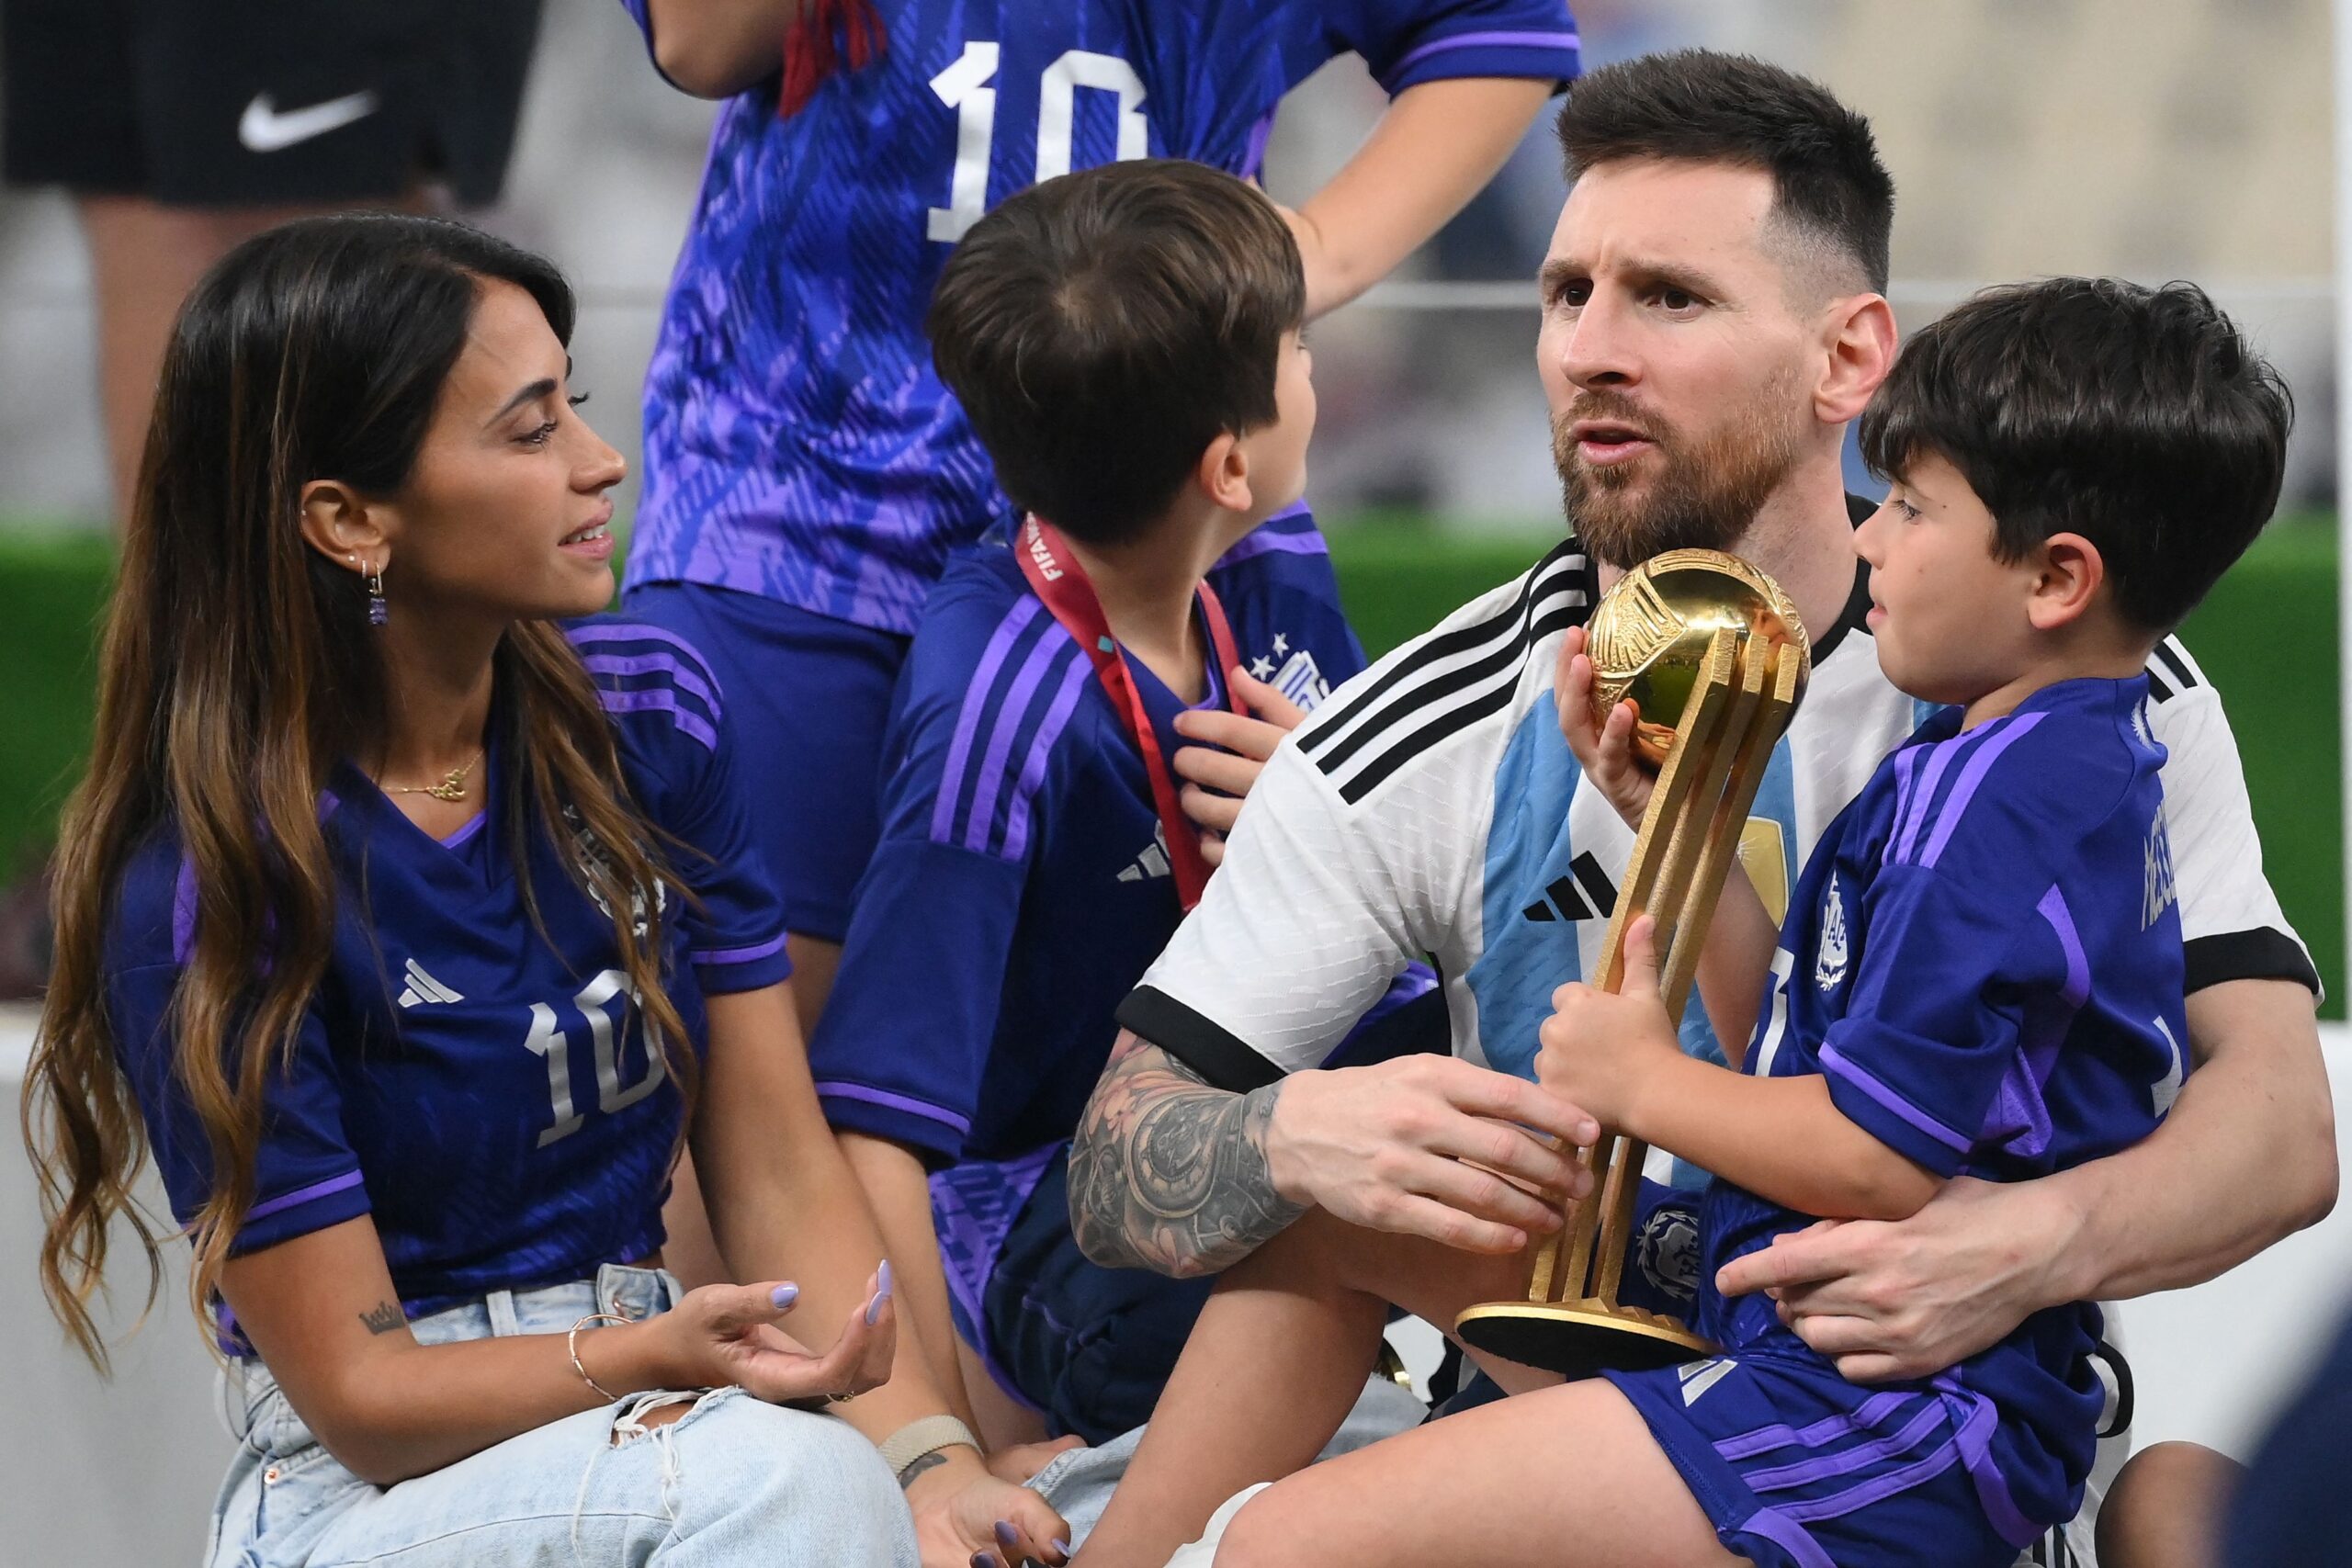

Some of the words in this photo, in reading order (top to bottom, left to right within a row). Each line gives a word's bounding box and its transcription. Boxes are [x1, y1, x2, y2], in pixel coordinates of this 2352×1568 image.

[927, 41, 1148, 243] 10
[1030, 537, 1064, 581] FIFA
[524, 969, 665, 1149] 10
